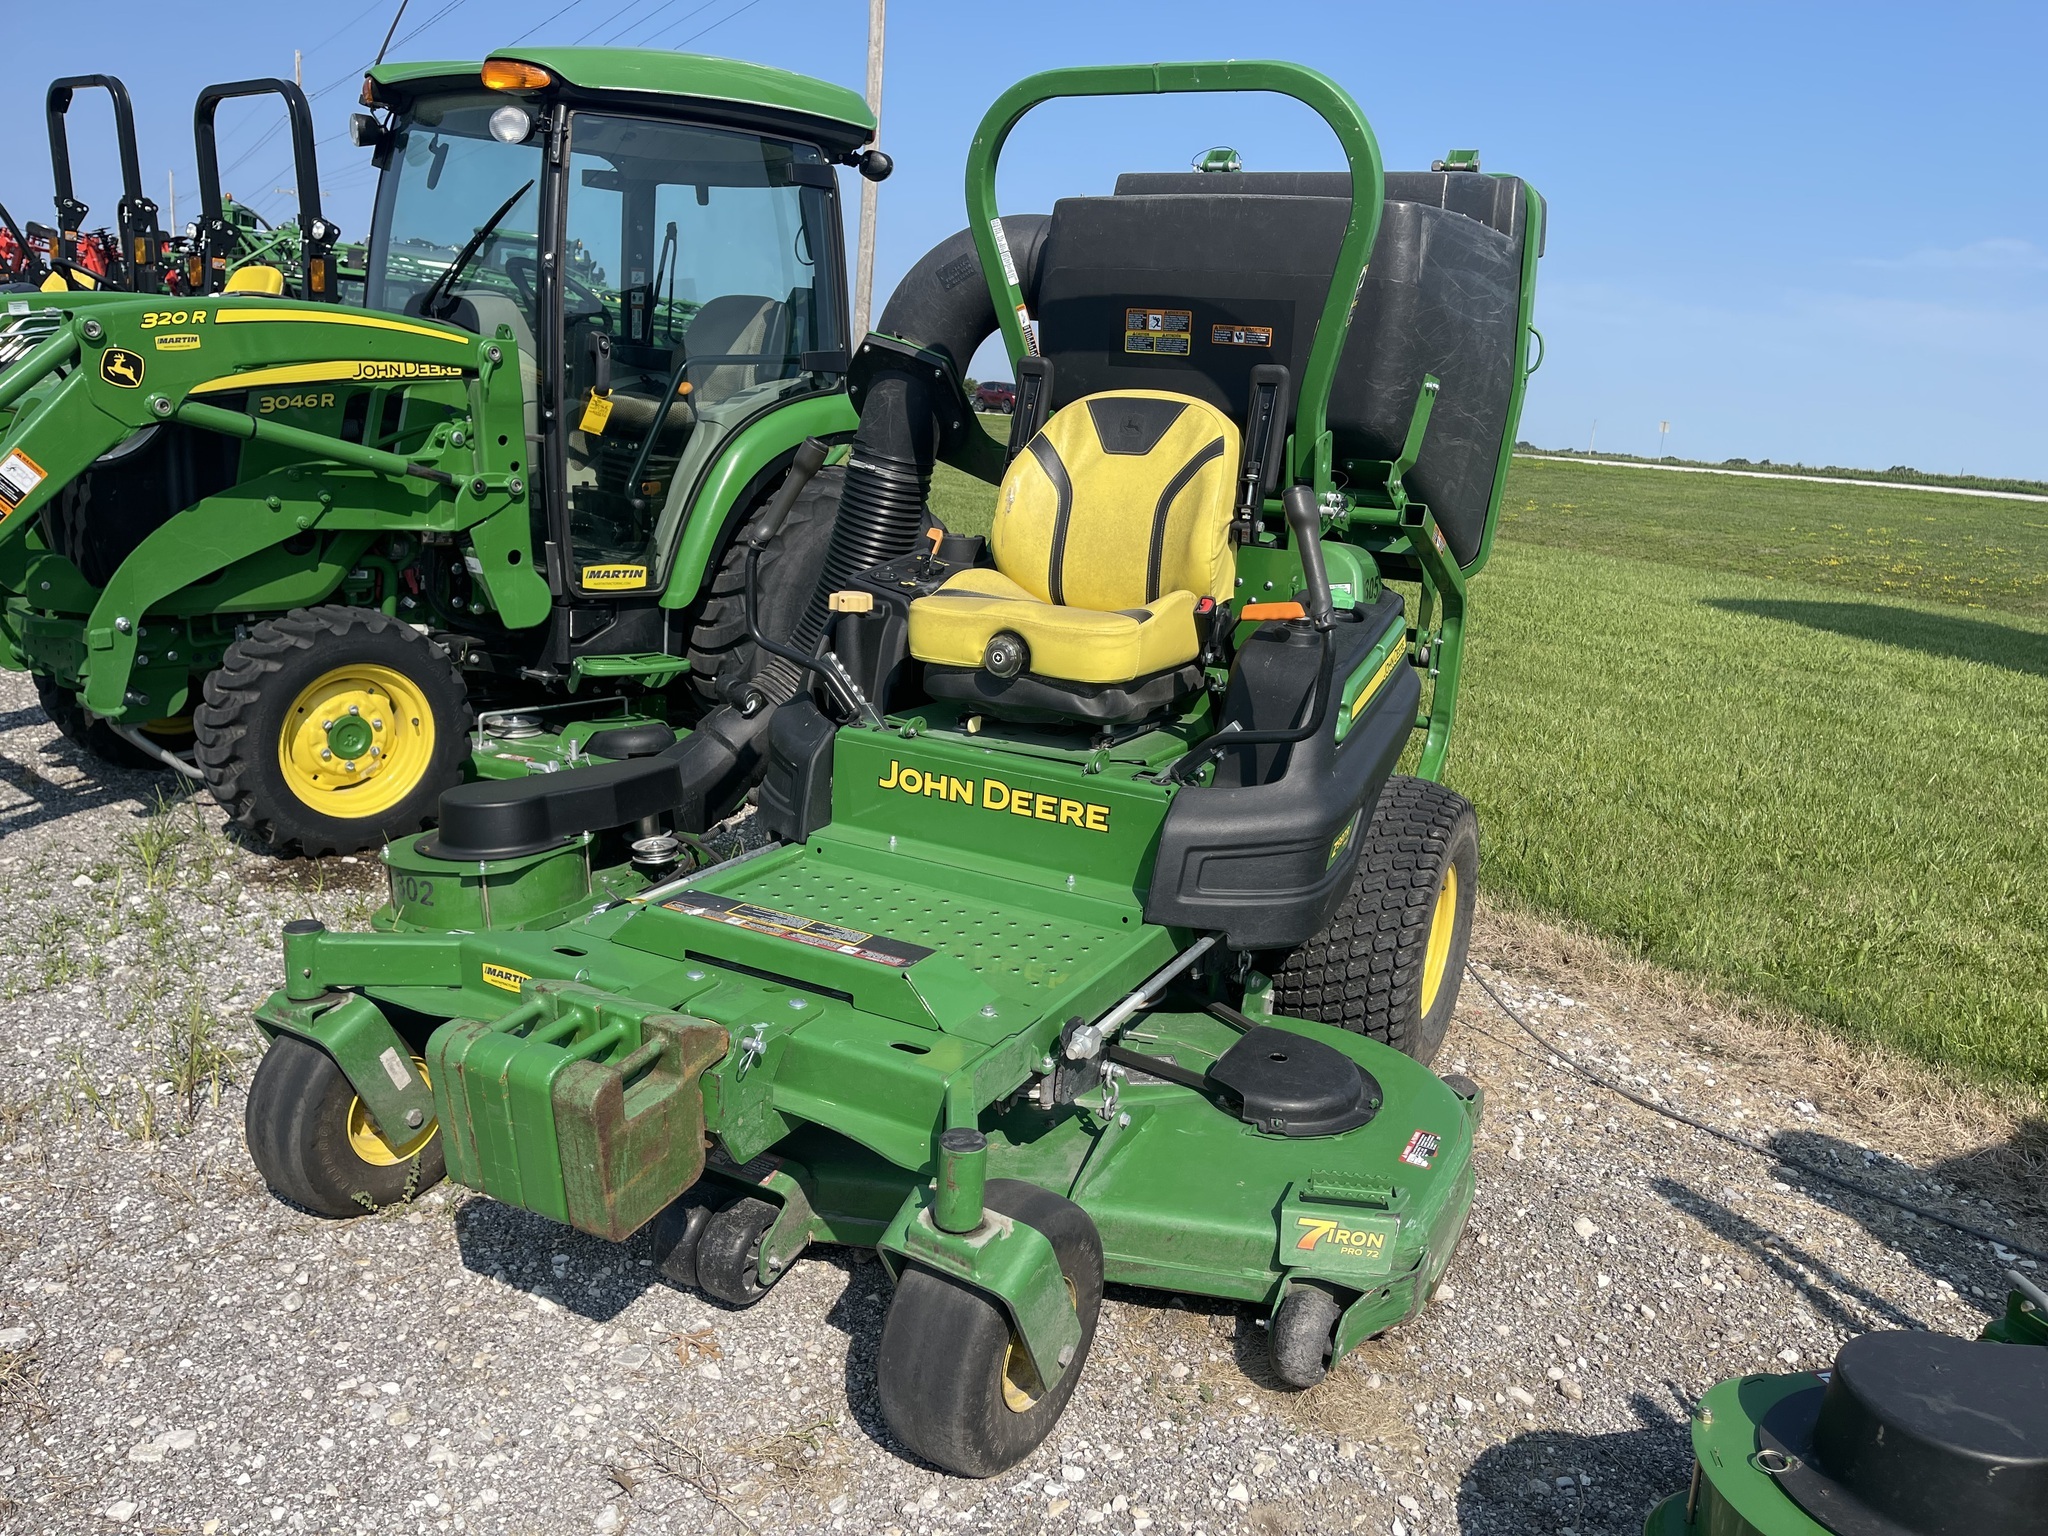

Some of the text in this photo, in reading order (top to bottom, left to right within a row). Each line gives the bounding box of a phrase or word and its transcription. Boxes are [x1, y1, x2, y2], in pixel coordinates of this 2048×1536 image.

[158, 336, 198, 344] MARTIN
[353, 362, 401, 379] JOHN
[587, 569, 644, 579] MARTIN
[878, 759, 1112, 833] JOHN DEERE
[1340, 1246, 1380, 1259] PRO 72
